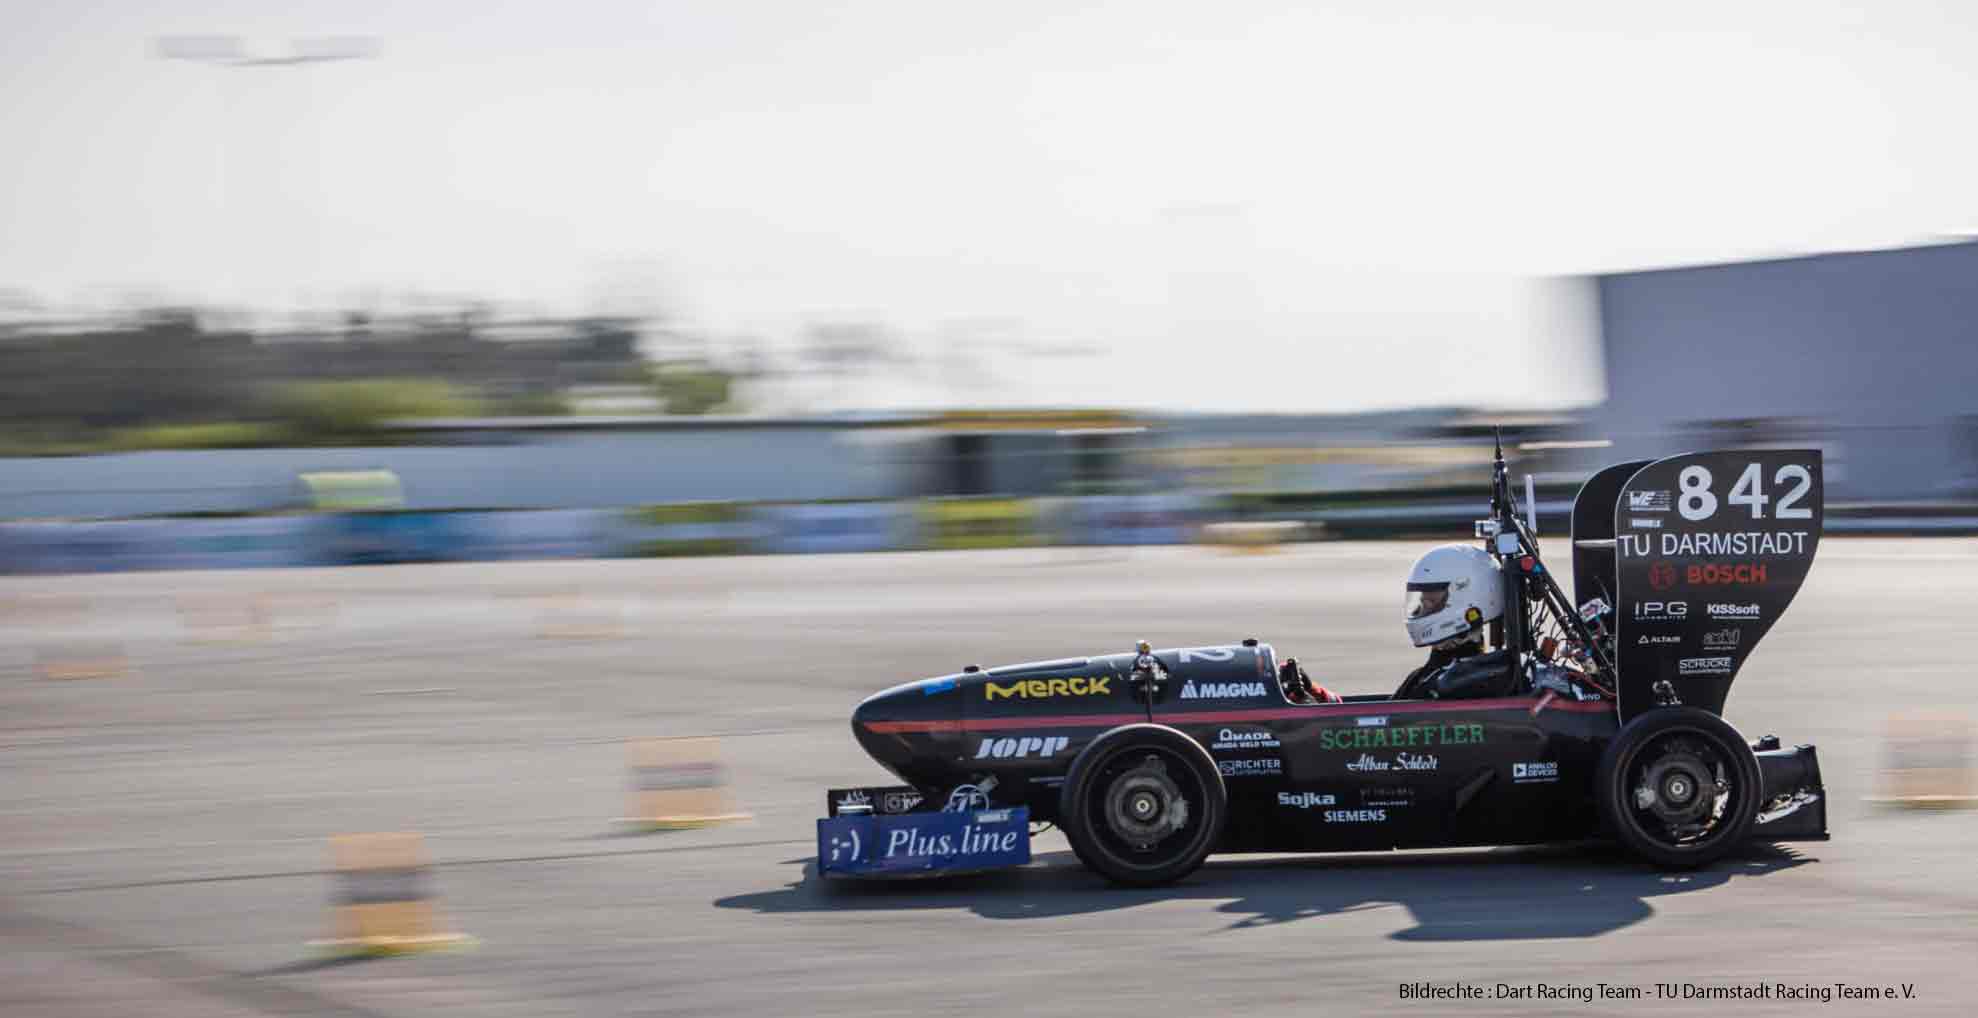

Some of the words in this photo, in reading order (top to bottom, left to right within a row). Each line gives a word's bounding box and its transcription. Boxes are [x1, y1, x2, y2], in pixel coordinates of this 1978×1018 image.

[1678, 463, 1813, 520] 842
[1618, 534, 1650, 556] TU
[1662, 532, 1808, 555] DARMSTADT
[1687, 564, 1767, 584] BOSCH
[1634, 601, 1688, 616] IPG
[1706, 603, 1760, 615] KISSsoft
[1201, 681, 1267, 698] MAGNA
[1320, 724, 1485, 750] SCHAEFFLER
[974, 736, 1070, 760] JOPP
[1235, 759, 1281, 769] RICHTER
[1346, 753, 1390, 771] Alban
[1277, 791, 1336, 808] Sojka
[1324, 809, 1387, 823] SIEMENS
[885, 824, 1018, 860] Plus.line
